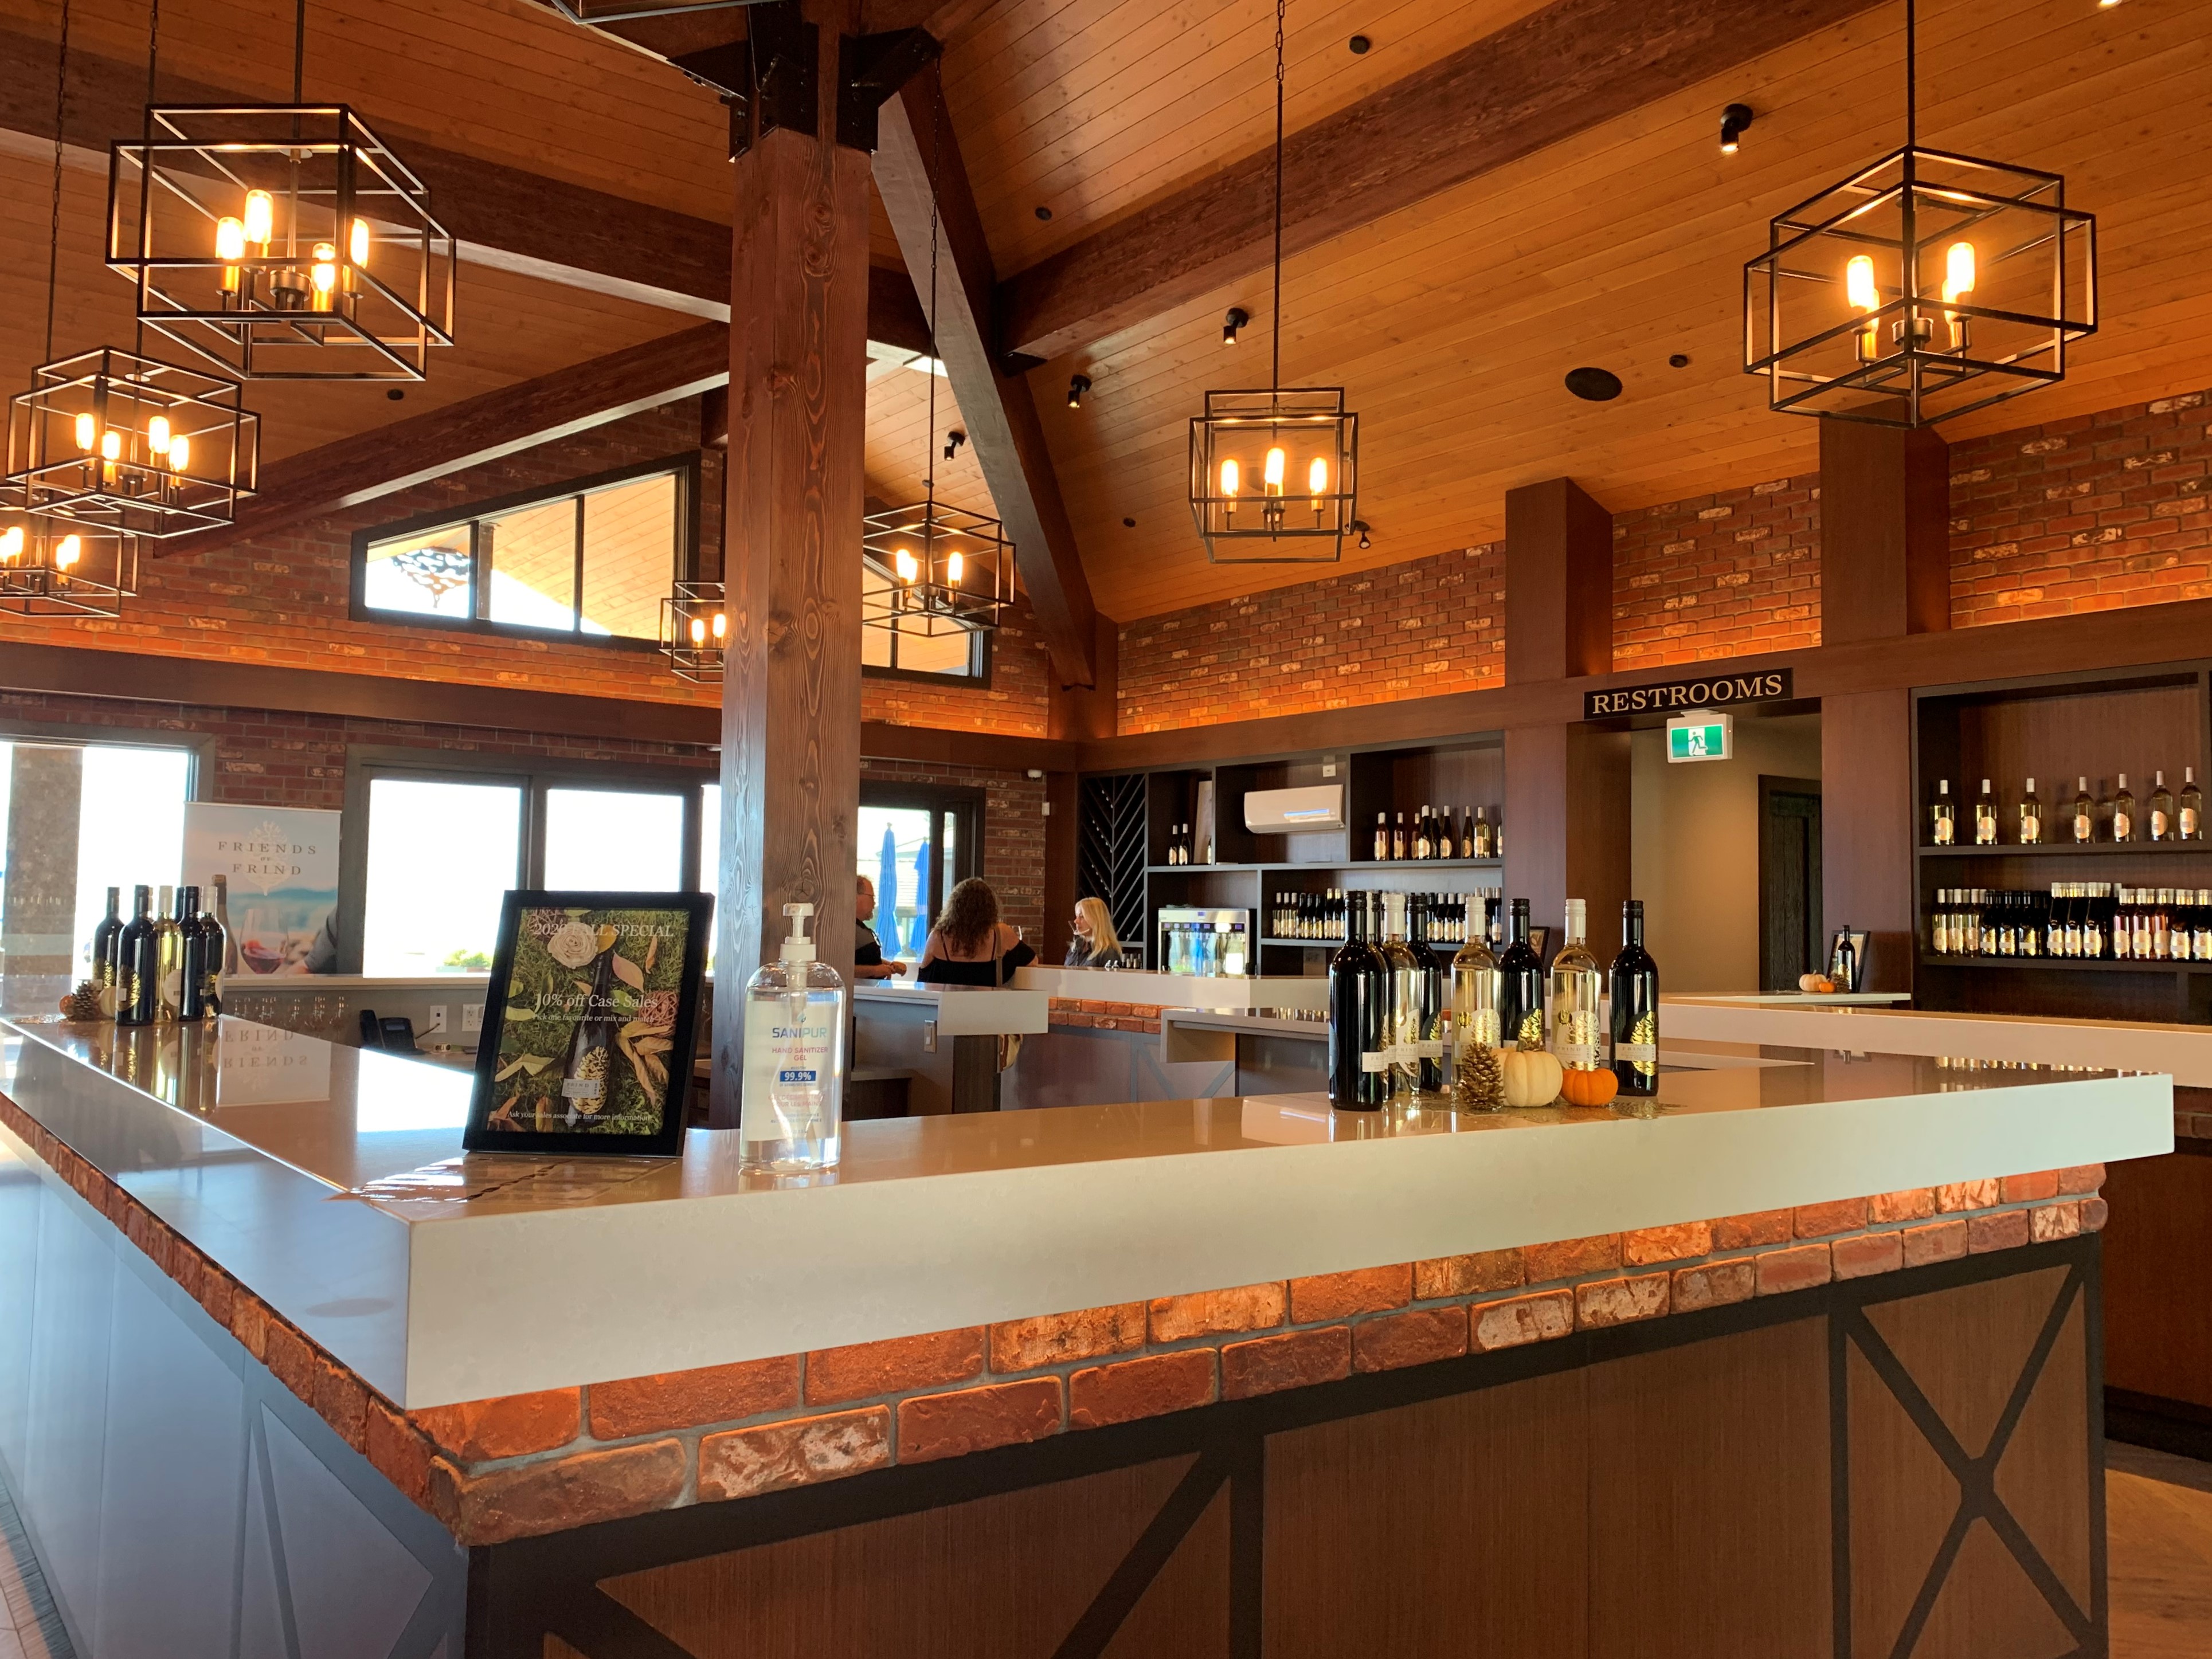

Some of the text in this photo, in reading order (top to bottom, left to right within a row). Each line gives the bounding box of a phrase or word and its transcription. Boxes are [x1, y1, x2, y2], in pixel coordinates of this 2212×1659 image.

[1592, 674, 1783, 714] RESTROOMS
[218, 841, 316, 854] FRIENDS
[233, 864, 301, 875] FRIND
[612, 924, 675, 938] SPECIAL
[566, 994, 586, 1006] off
[588, 994, 620, 1007] Case
[623, 995, 658, 1007] Sales
[562, 1014, 593, 1022] favourite
[772, 1027, 827, 1038] SANIPUR
[784, 1071, 812, 1081] 99.9%
